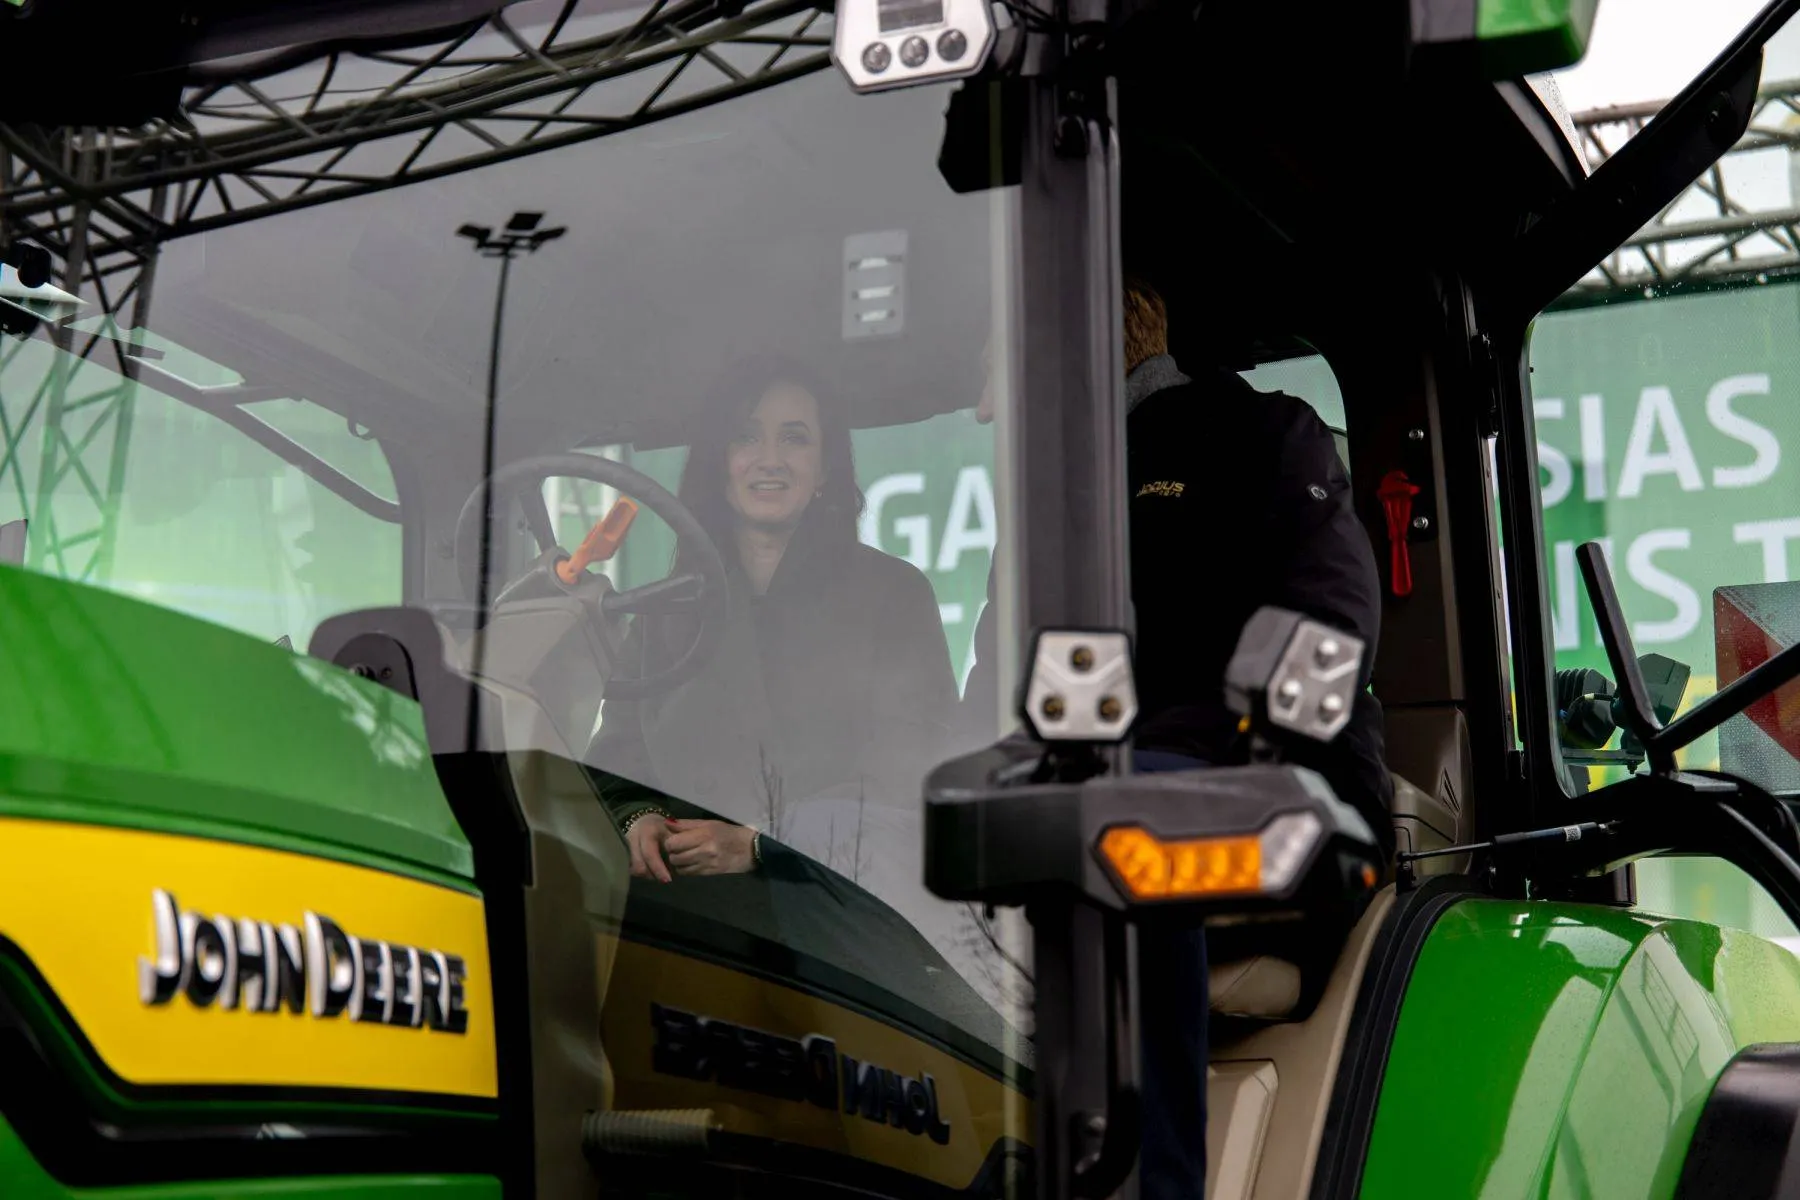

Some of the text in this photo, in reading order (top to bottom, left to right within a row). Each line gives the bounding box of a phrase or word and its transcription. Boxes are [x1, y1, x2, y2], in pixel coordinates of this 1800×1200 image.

[856, 464, 997, 572] GA
[137, 887, 468, 1034] JOHN DEERE
